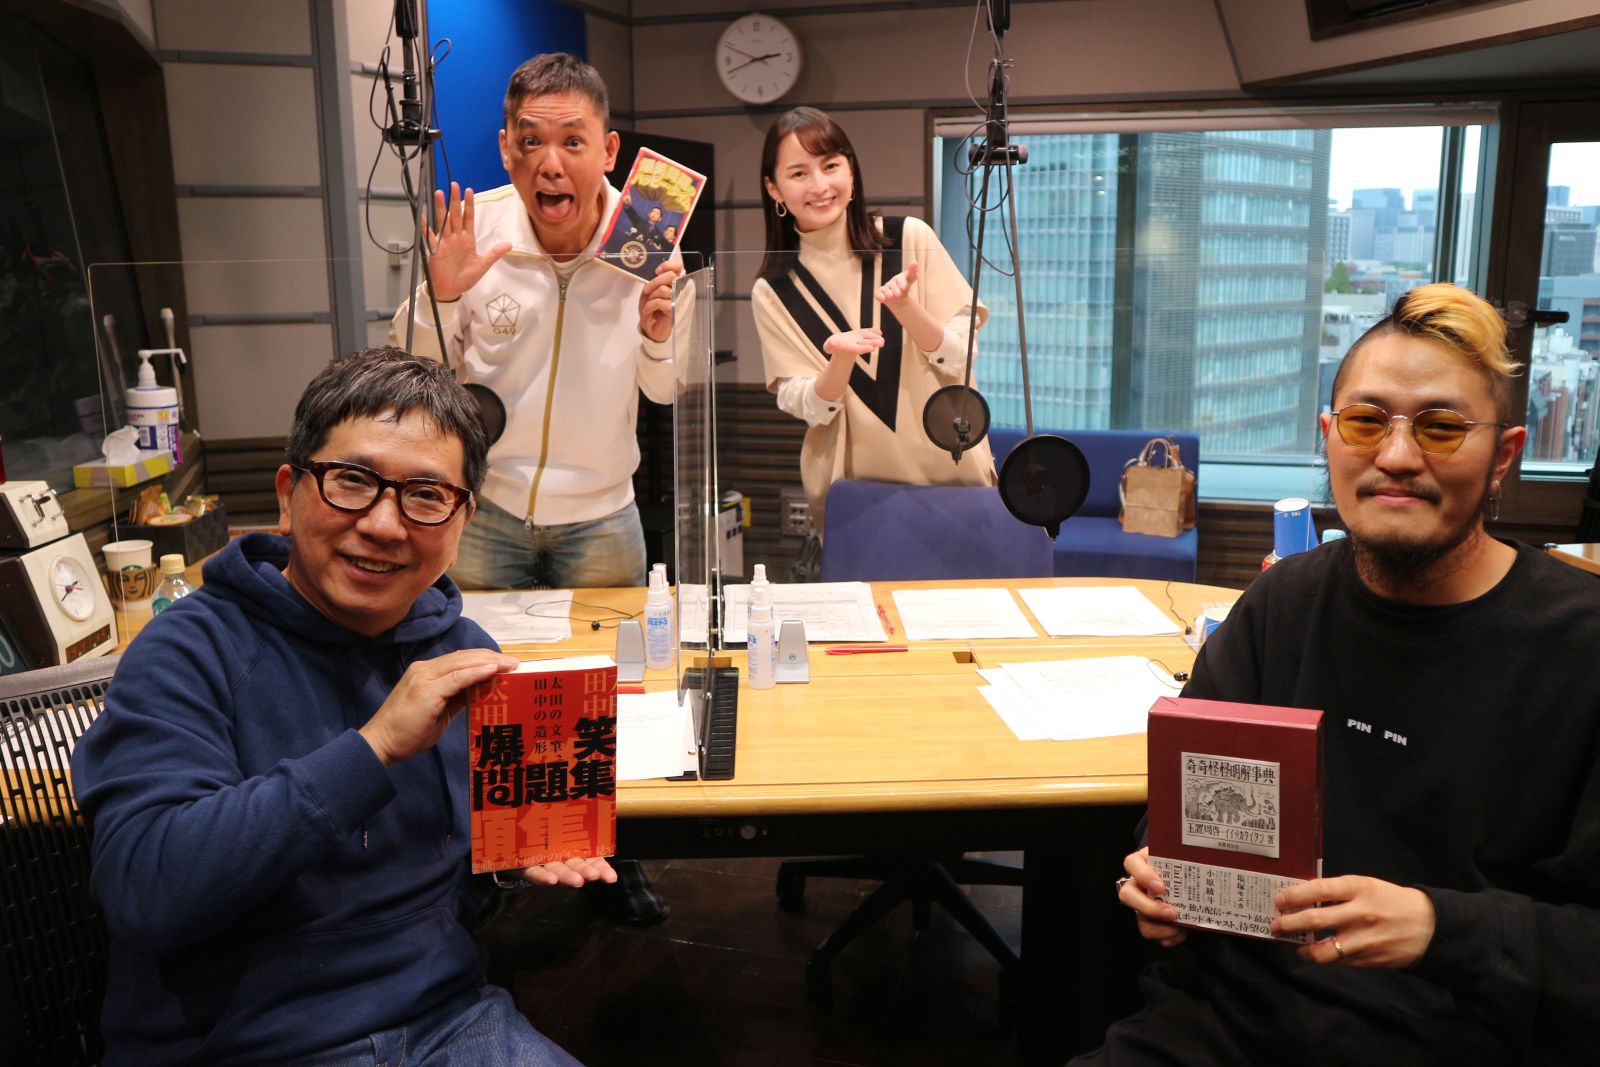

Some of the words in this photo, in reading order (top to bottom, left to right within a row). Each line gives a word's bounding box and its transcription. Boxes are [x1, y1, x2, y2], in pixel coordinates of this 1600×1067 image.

[1347, 718, 1372, 734] PIN
[1384, 730, 1408, 747] PIN
[1186, 758, 1276, 784] 奇奇怪怪明解事典
[472, 760, 616, 811] 問題集
[1188, 904, 1274, 925] 独占配信・チャート最高
